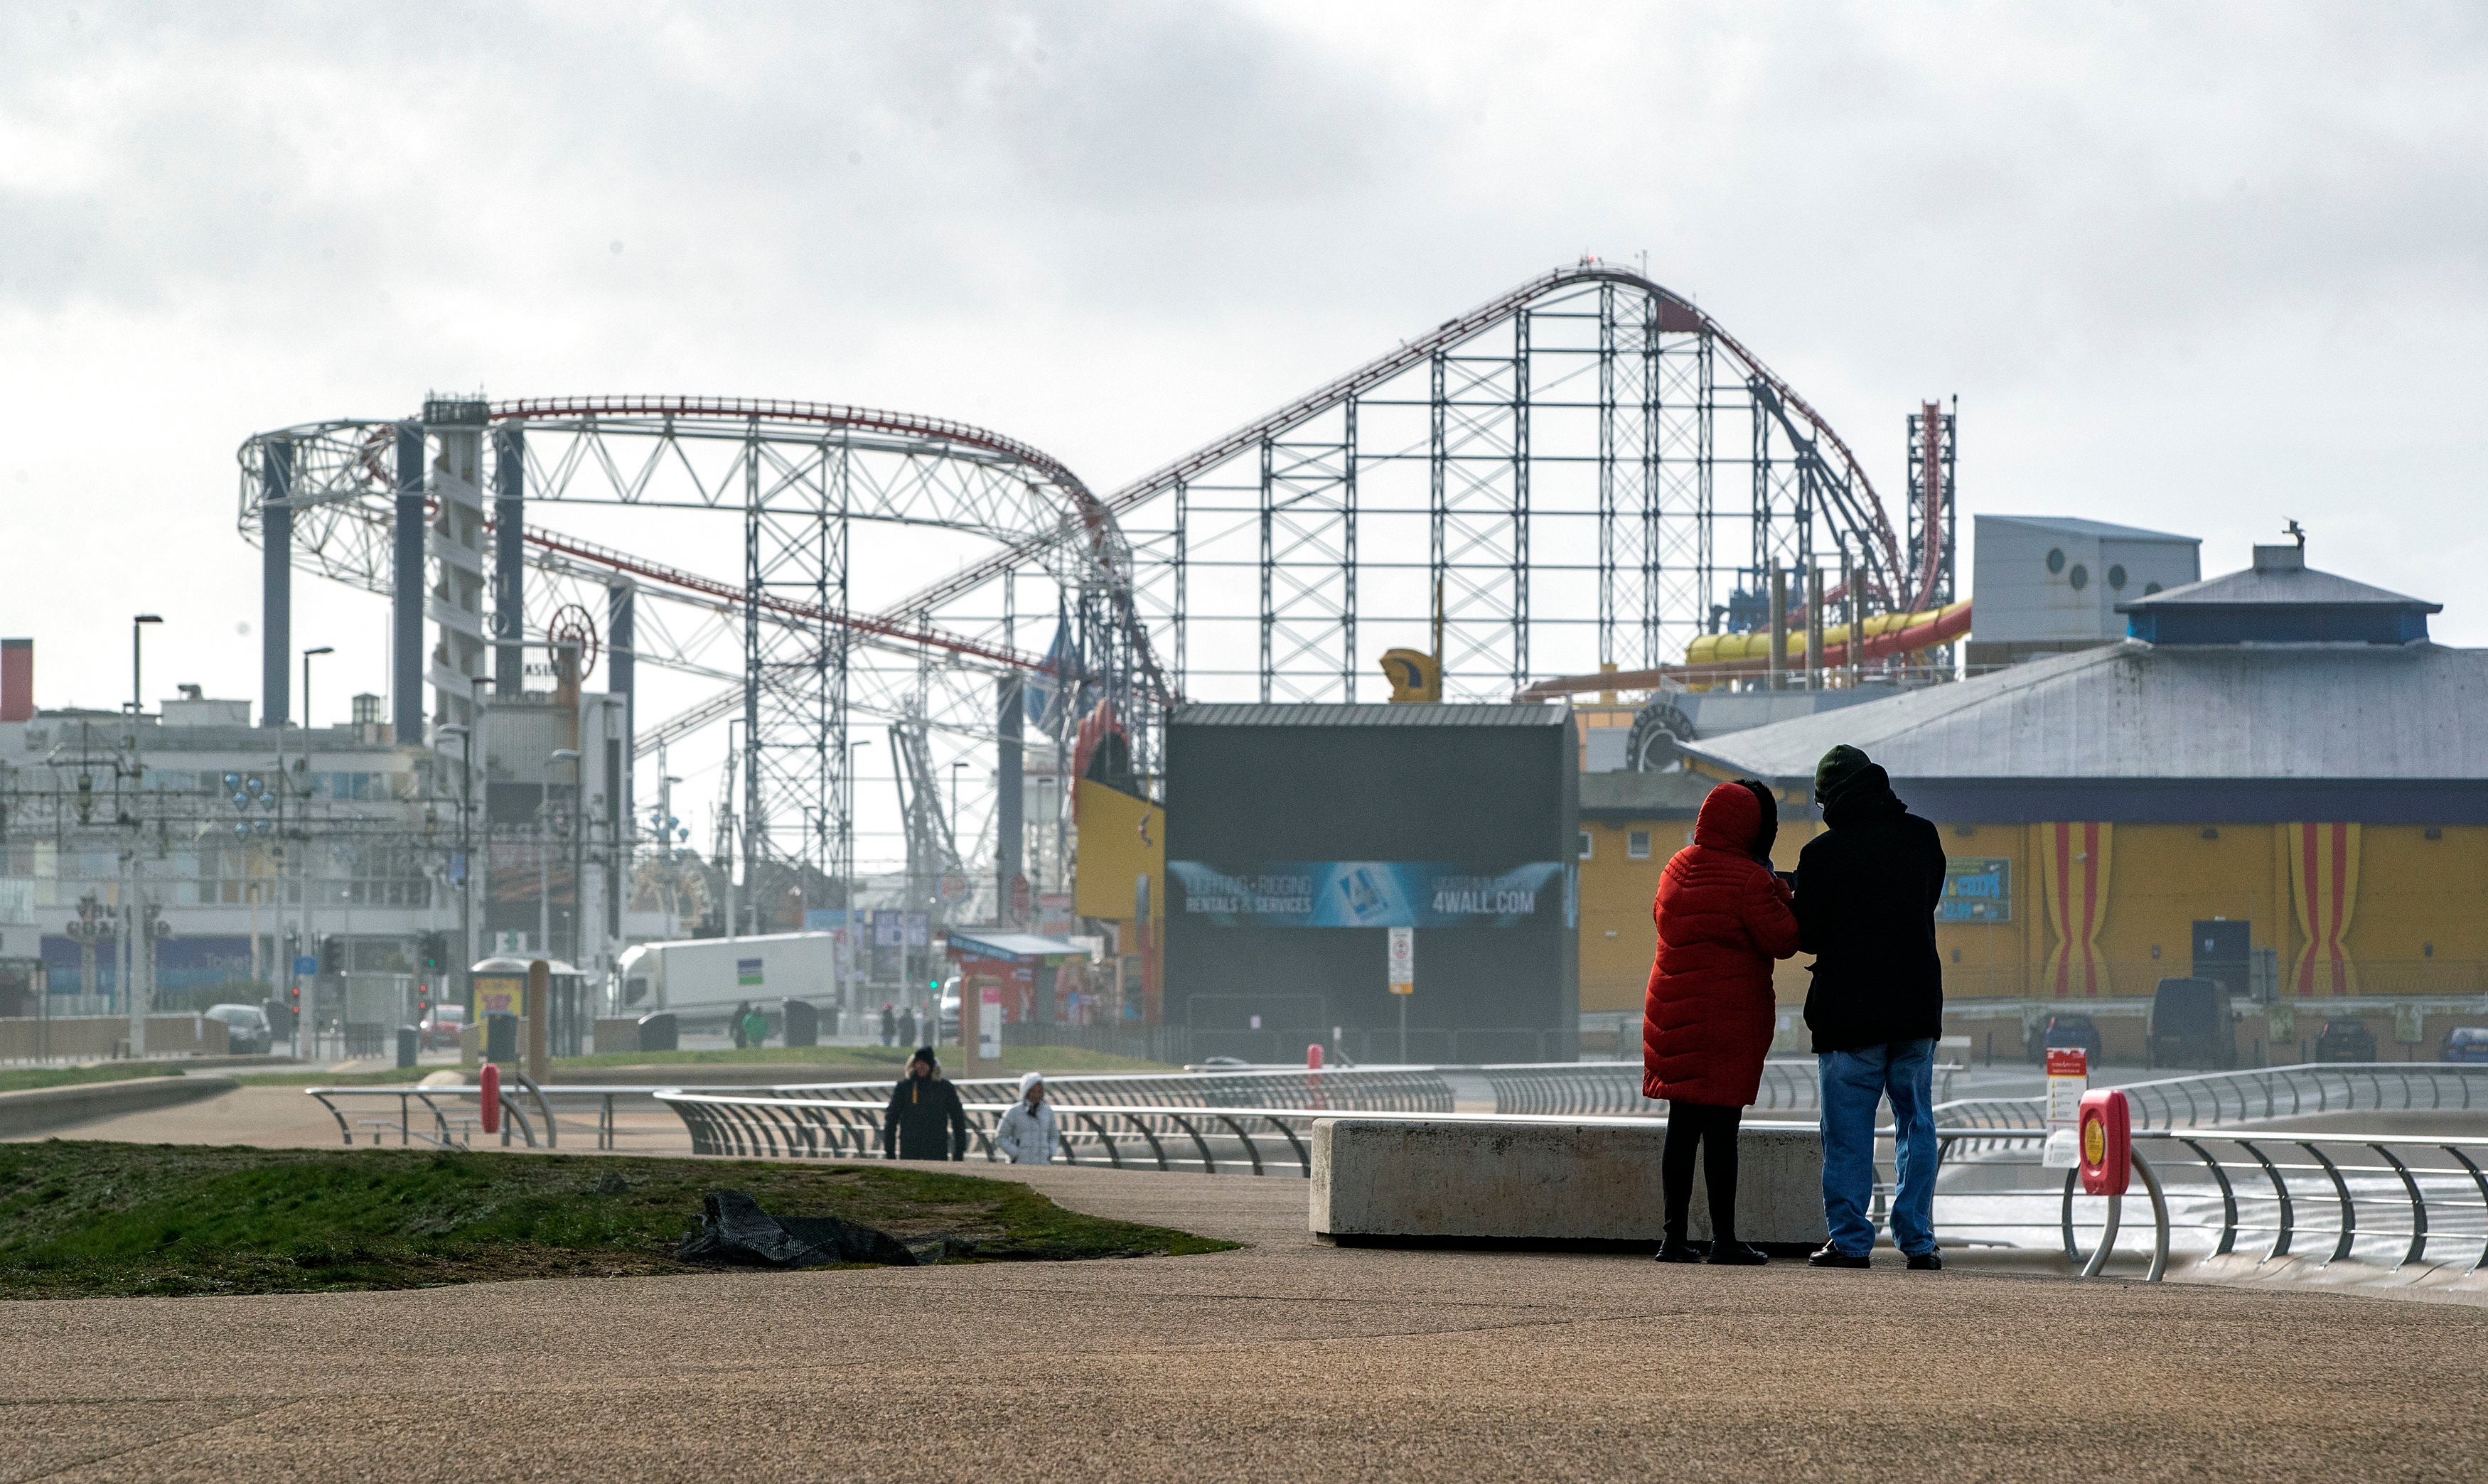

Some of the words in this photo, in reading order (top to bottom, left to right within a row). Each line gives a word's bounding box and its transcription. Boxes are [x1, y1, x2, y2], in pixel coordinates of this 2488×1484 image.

[1186, 897, 1239, 913] RENTALS
[1255, 896, 1312, 913] SERVICES
[1432, 890, 1535, 914] 4WALL.COM
